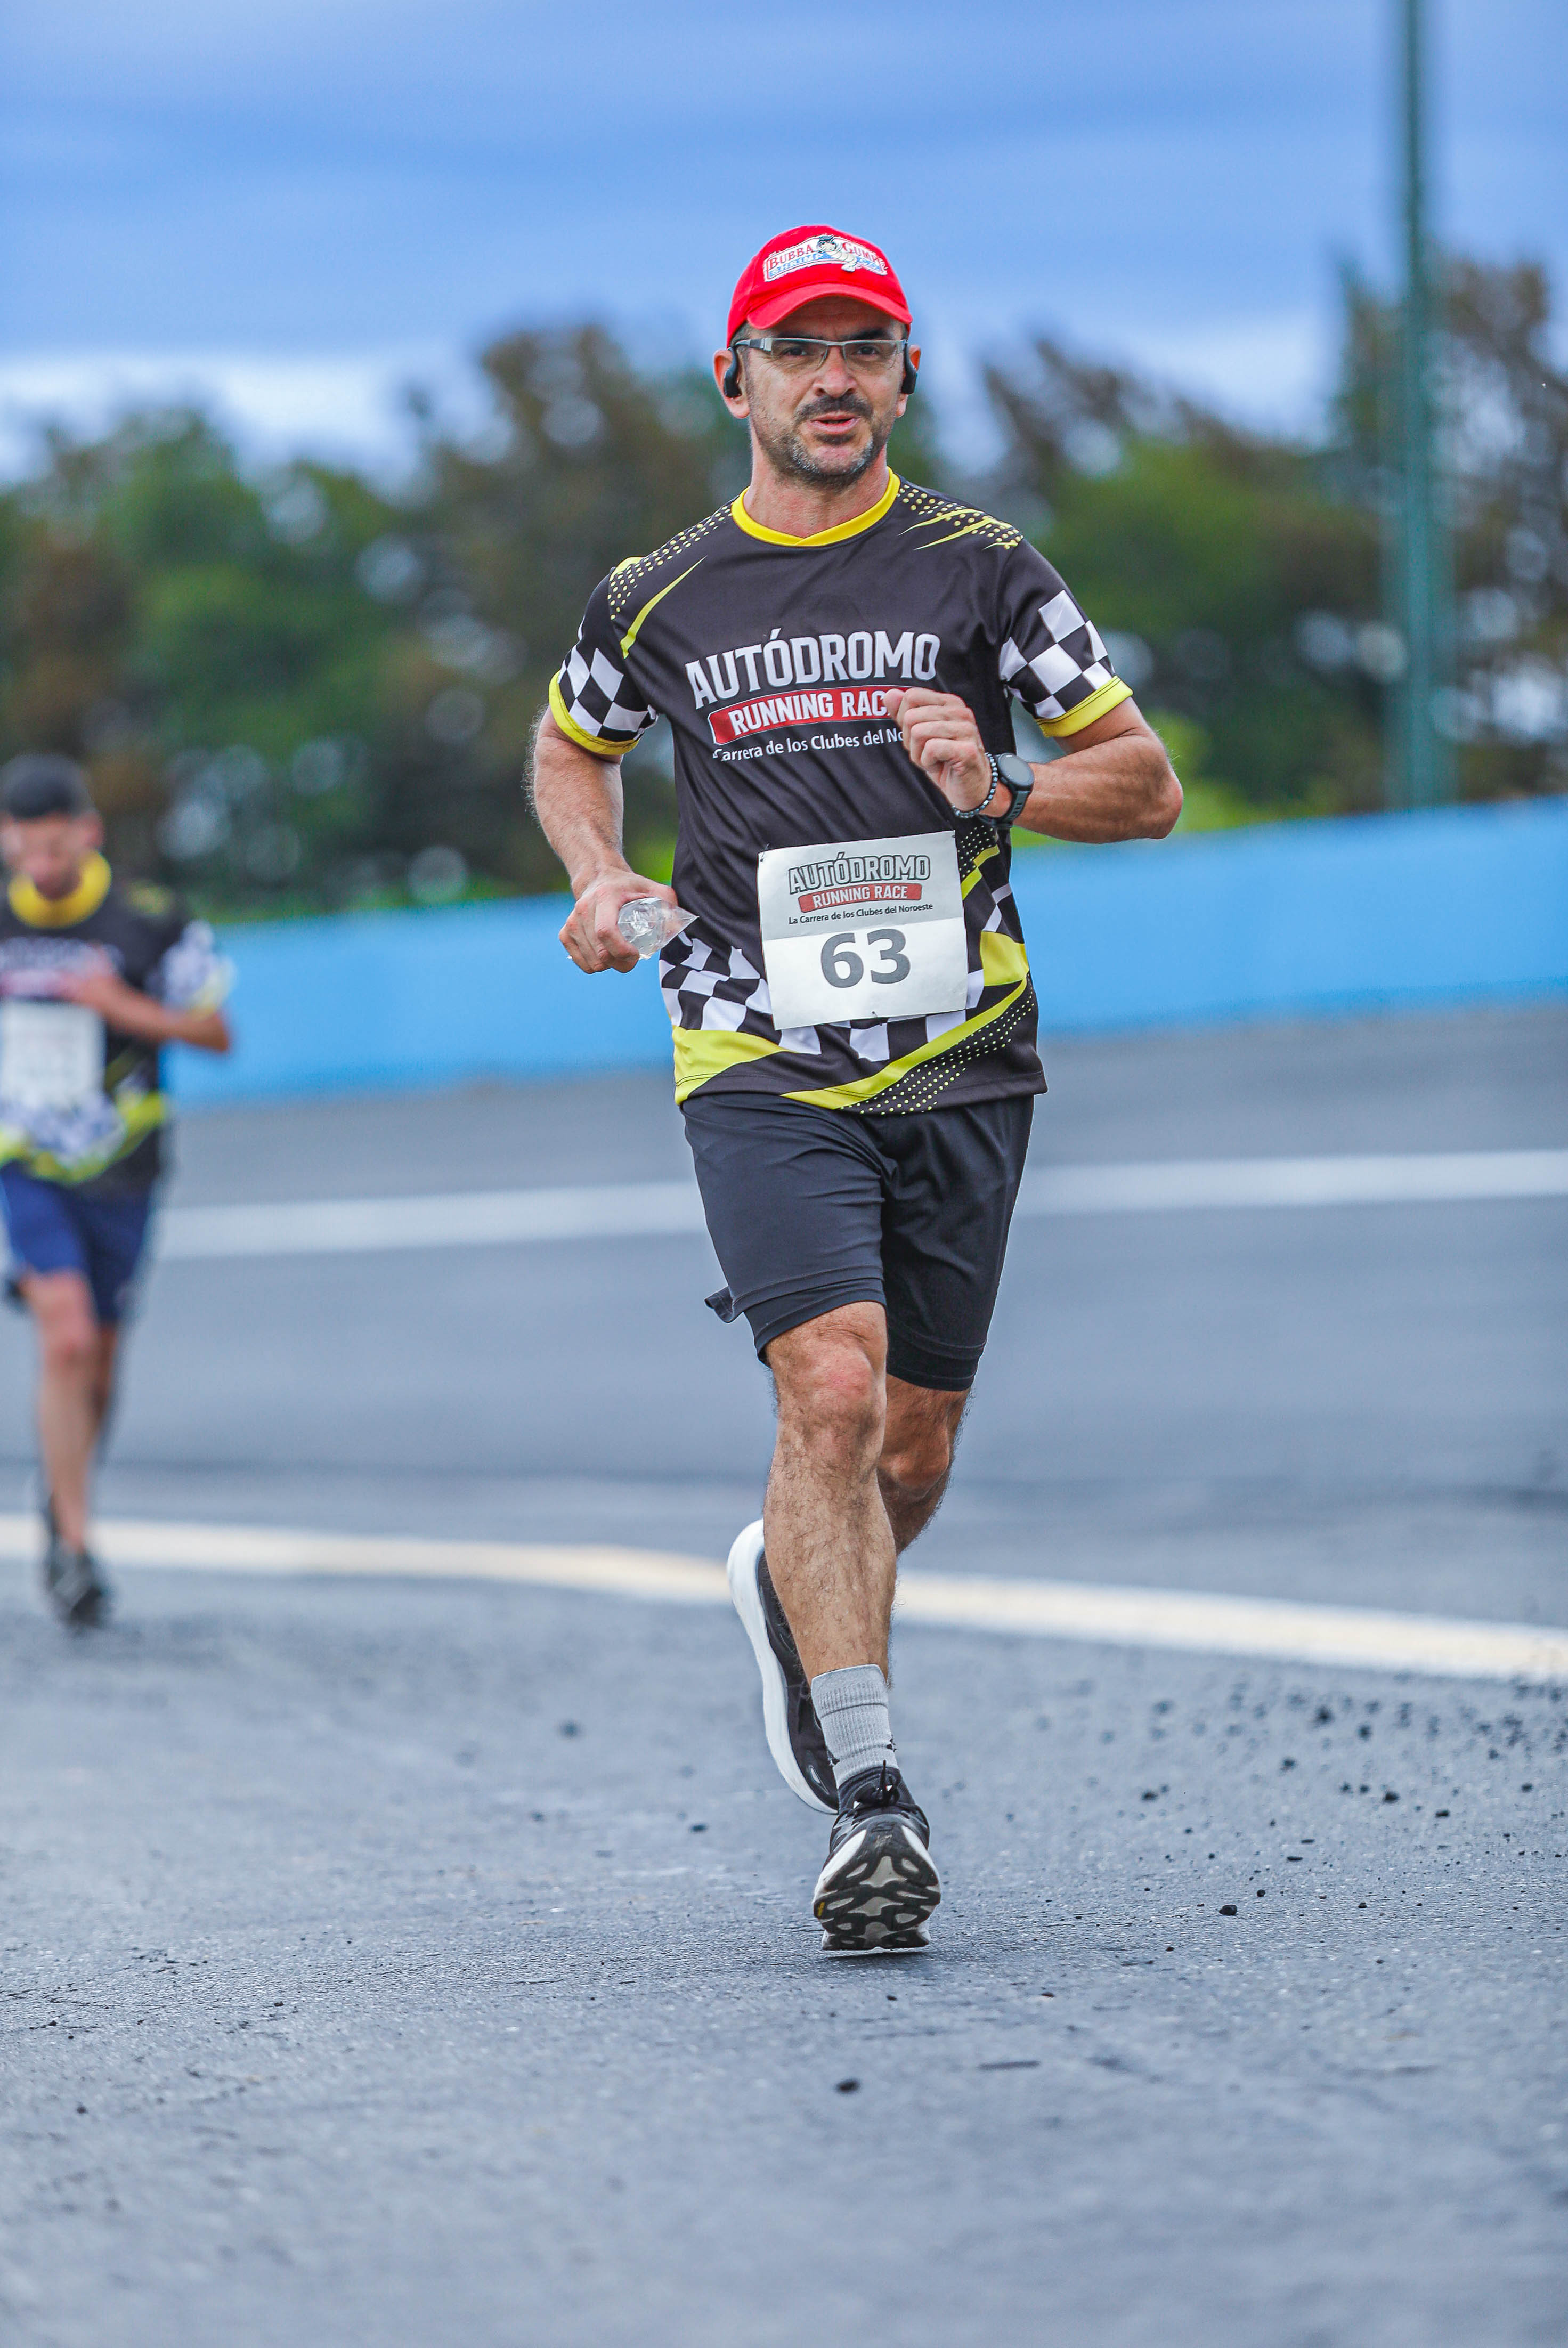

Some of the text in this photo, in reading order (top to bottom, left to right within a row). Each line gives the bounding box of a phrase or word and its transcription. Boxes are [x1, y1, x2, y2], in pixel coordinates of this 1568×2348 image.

[769, 242, 879, 270] BUBBA GUMP
[685, 628, 941, 709] AUTÓDROMO
[728, 690, 891, 736] RUNNING RAC
[766, 740, 784, 755] de
[786, 737, 808, 752] los
[810, 733, 860, 750] Clubes
[863, 729, 884, 745] del
[788, 852, 930, 895] AUTÓDROMO
[800, 914, 829, 923] Carrera
[831, 912, 841, 920] de
[856, 907, 883, 917] Clubes
[885, 905, 897, 914] del
[899, 903, 933, 913] Noroeste
[812, 884, 908, 909] RUNNING RACE
[820, 928, 911, 988] 63
